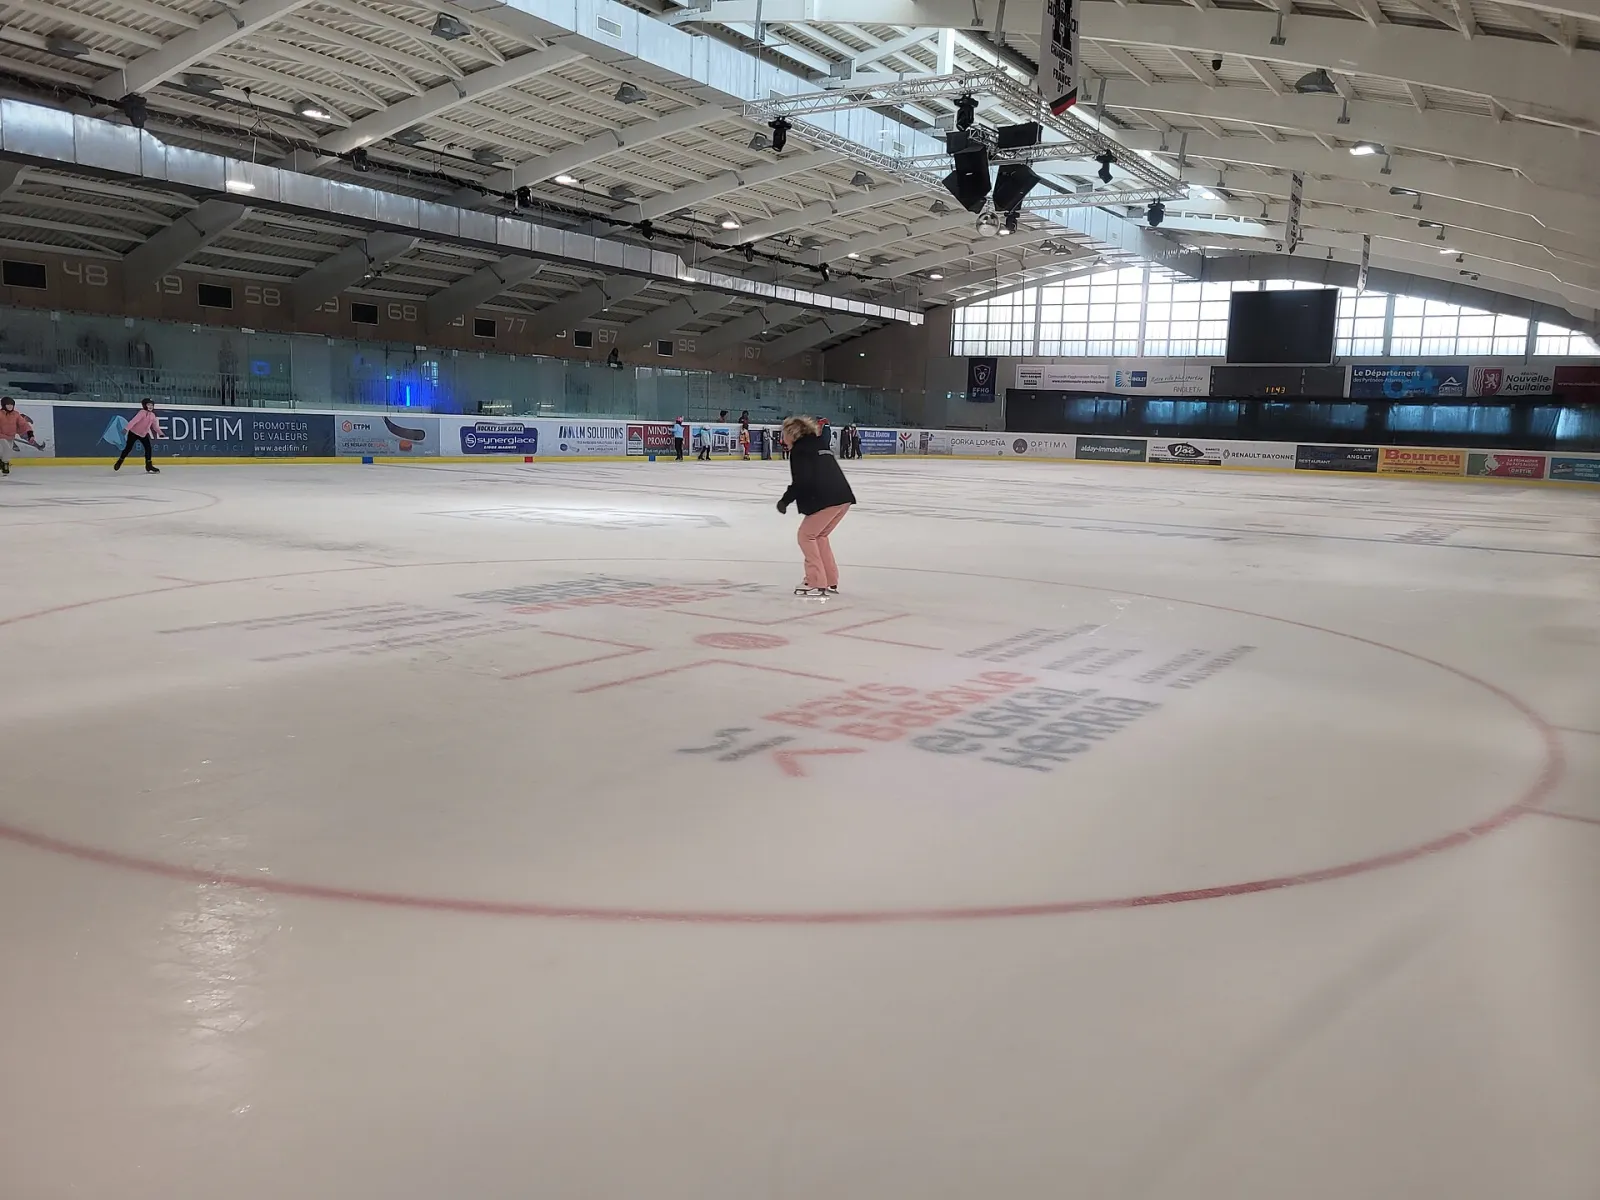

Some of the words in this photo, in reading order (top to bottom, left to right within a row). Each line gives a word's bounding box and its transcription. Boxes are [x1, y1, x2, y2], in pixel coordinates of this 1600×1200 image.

[1052, 68, 1072, 87] FRANCE
[63, 260, 109, 287] 48
[244, 285, 281, 307] 58
[387, 303, 418, 322] 68
[504, 317, 527, 334] 77
[598, 329, 618, 344] 87
[1365, 369, 1420, 378] Département
[1506, 374, 1552, 382] Nouvelle-
[1505, 382, 1551, 392] Aquitaine
[253, 422, 308, 431] PROMOTEUR
[254, 432, 266, 440] DE
[268, 432, 308, 442] VALEURS
[587, 426, 624, 439] SOLUTIONS
[477, 436, 536, 445] synerglace
[951, 438, 974, 446] GORKA
[1030, 440, 1068, 448] OPTIMA
[1384, 449, 1460, 464] Bouney
